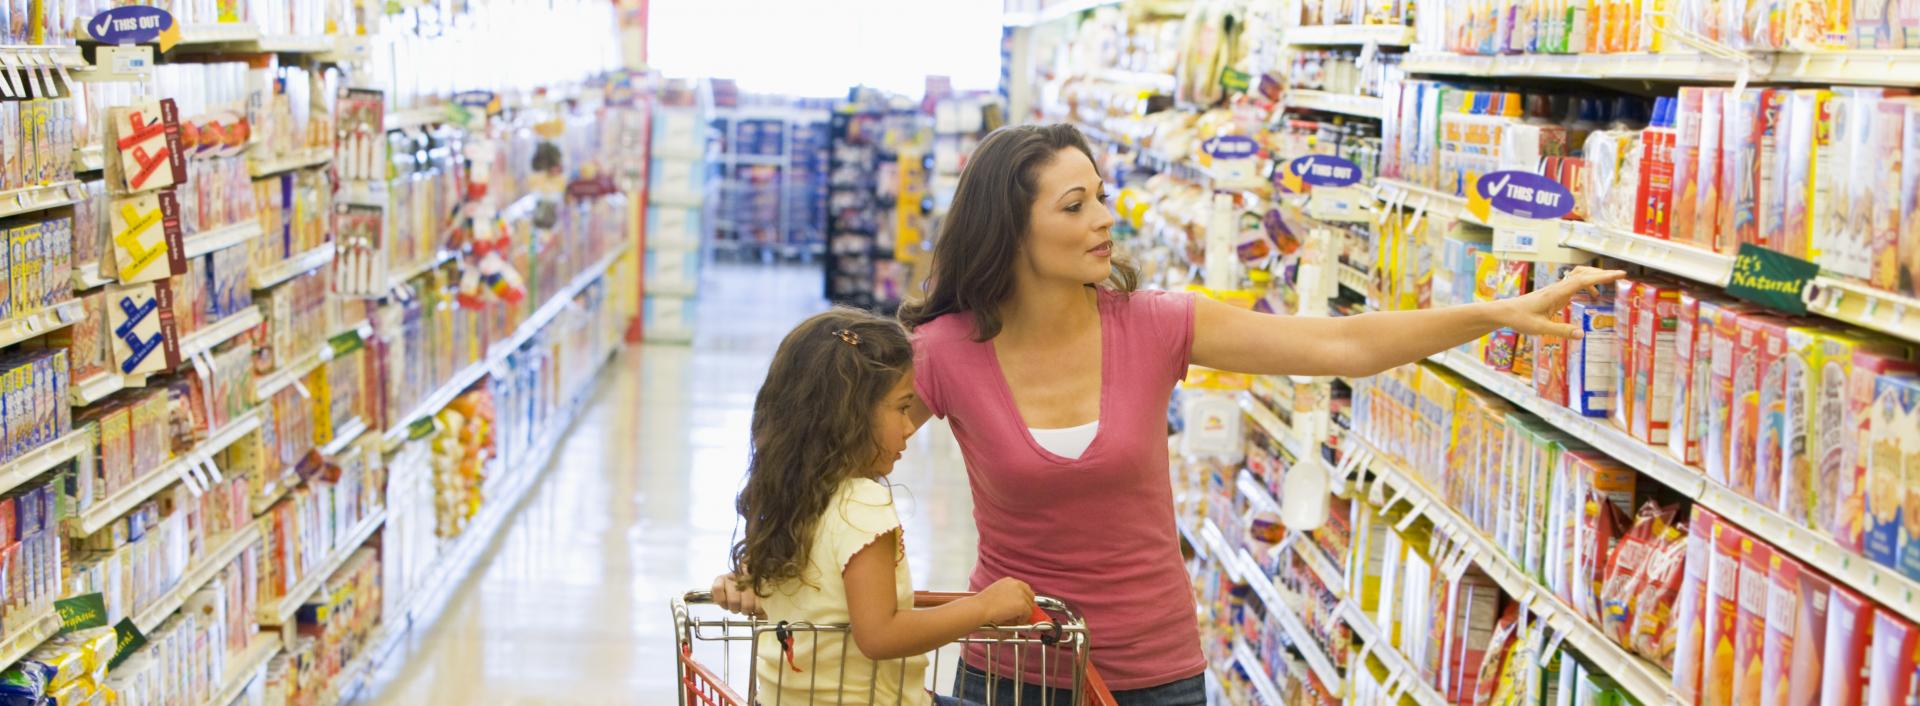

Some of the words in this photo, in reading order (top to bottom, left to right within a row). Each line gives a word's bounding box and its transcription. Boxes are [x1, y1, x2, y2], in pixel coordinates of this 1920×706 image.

[113, 17, 137, 32] THIS
[139, 15, 160, 29] OUT
[1506, 183, 1534, 202] THIS
[1536, 190, 1561, 207] OUT
[1734, 255, 1761, 273] It's
[1733, 271, 1801, 294] Natural
